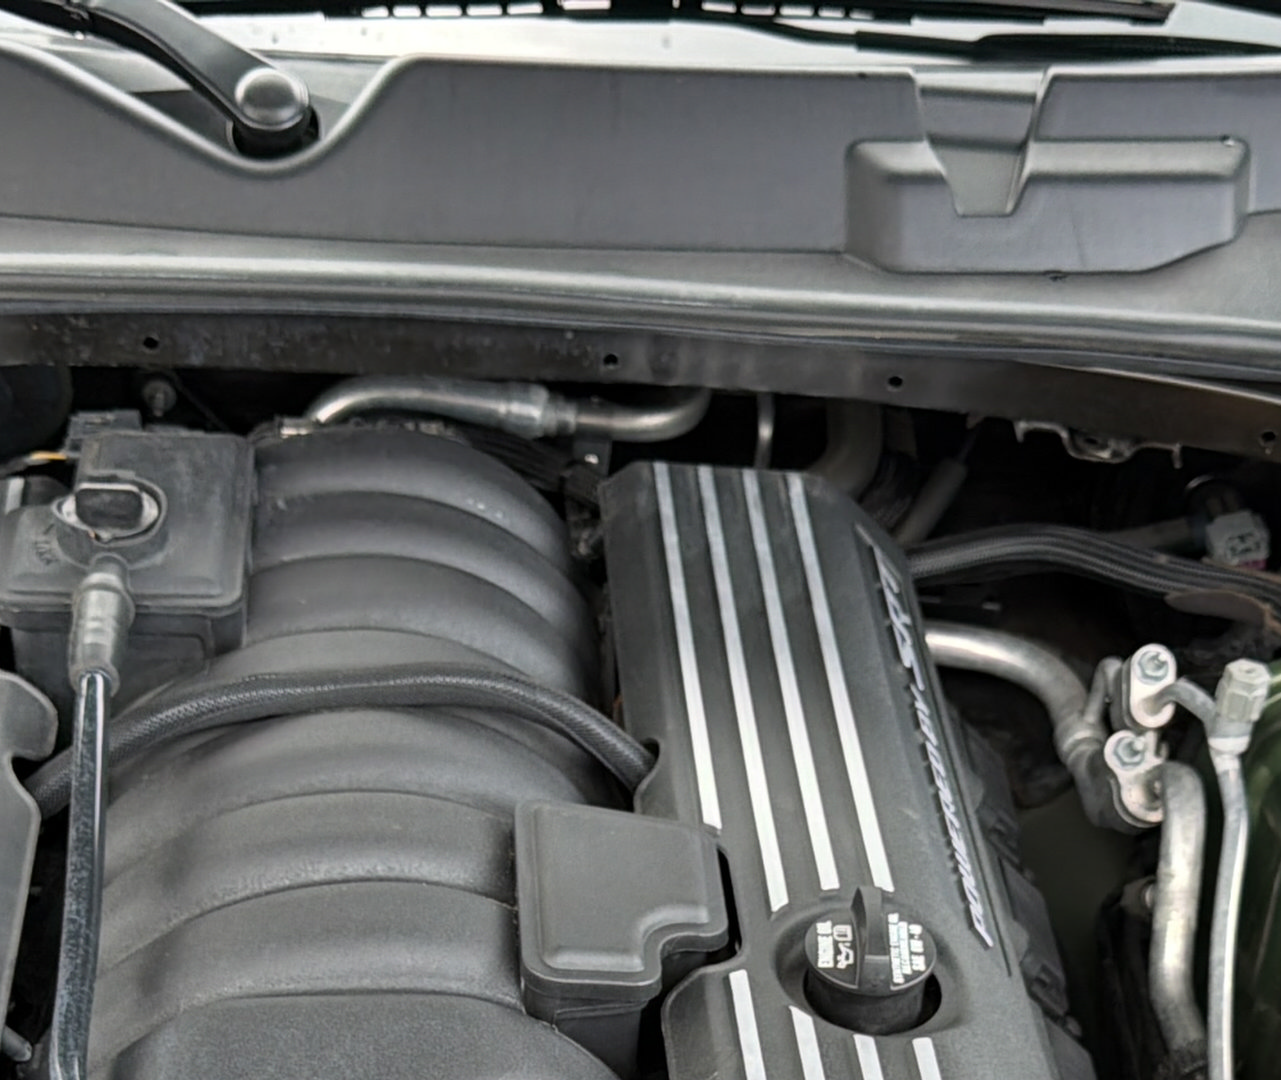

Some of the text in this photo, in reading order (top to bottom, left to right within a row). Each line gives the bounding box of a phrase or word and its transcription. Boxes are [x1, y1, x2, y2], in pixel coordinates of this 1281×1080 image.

[873, 544, 994, 948] POWERED BY SRT
